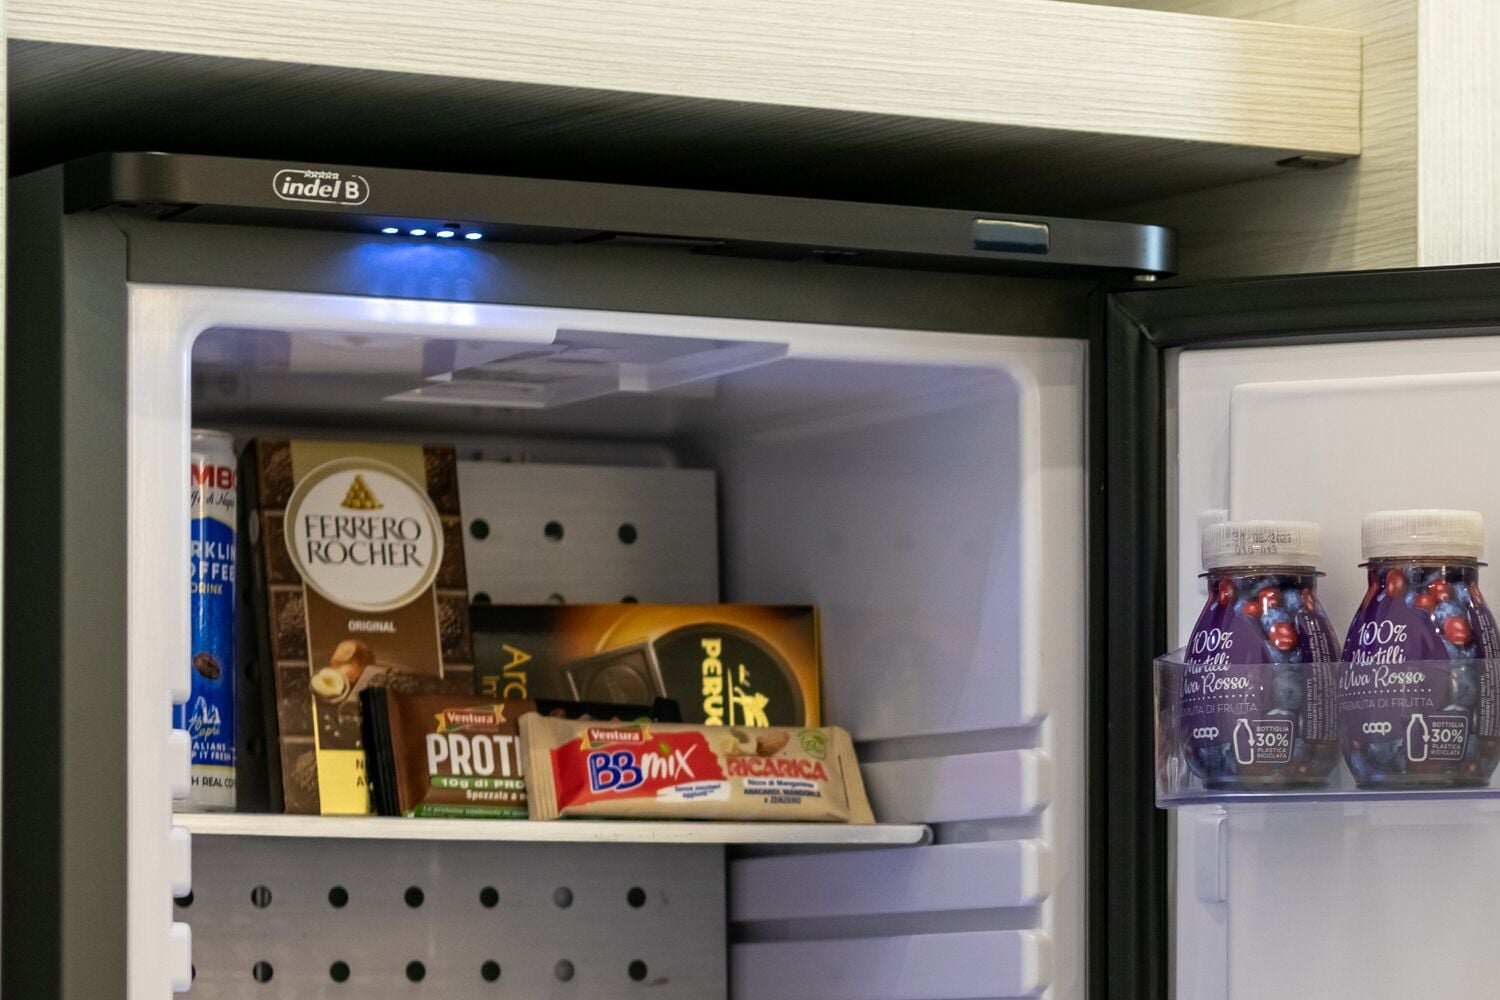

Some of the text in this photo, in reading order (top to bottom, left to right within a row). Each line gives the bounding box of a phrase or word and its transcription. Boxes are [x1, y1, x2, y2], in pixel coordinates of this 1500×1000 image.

[282, 177, 341, 198] indel
[305, 514, 421, 541] FERRERO
[307, 540, 423, 568] ROCHER
[348, 620, 397, 634] ORIGINAL
[1358, 619, 1408, 645] 100%
[1192, 628, 1233, 654] 100%
[1372, 664, 1425, 689] Rossa
[1391, 697, 1434, 708] FRUTTA
[447, 712, 494, 724] Ventura
[1193, 727, 1219, 740] coop
[1362, 721, 1392, 735] coop
[591, 729, 640, 742] Ventura
[1256, 733, 1289, 747] 30%
[1431, 728, 1464, 743] 30%
[726, 756, 828, 783] RICARICA
[202, 776, 222, 788] REAL
[441, 777, 469, 789] 10g
[474, 776, 488, 788] di
